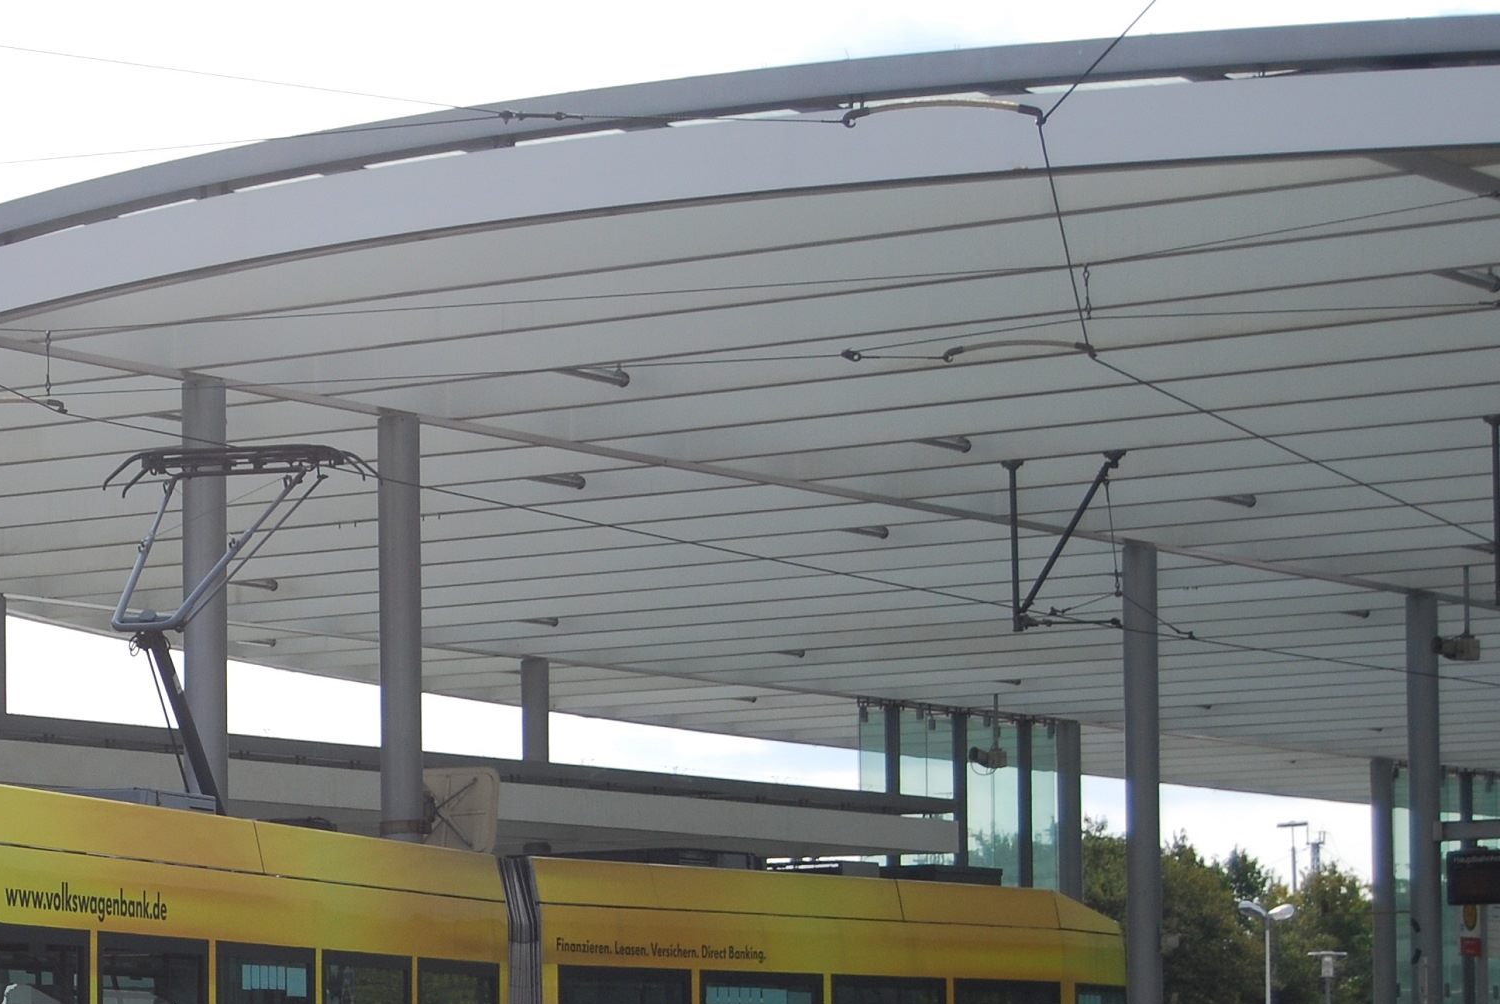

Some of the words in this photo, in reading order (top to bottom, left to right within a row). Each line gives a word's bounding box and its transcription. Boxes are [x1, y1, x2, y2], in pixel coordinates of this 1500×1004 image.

[5, 881, 168, 923] www.volkswagenbank.de
[556, 936, 612, 955] Finanzieren.
[614, 940, 649, 957] Leasen.
[650, 943, 699, 959] Versichern.
[701, 945, 727, 960] Direct
[729, 945, 767, 963] Banking.
